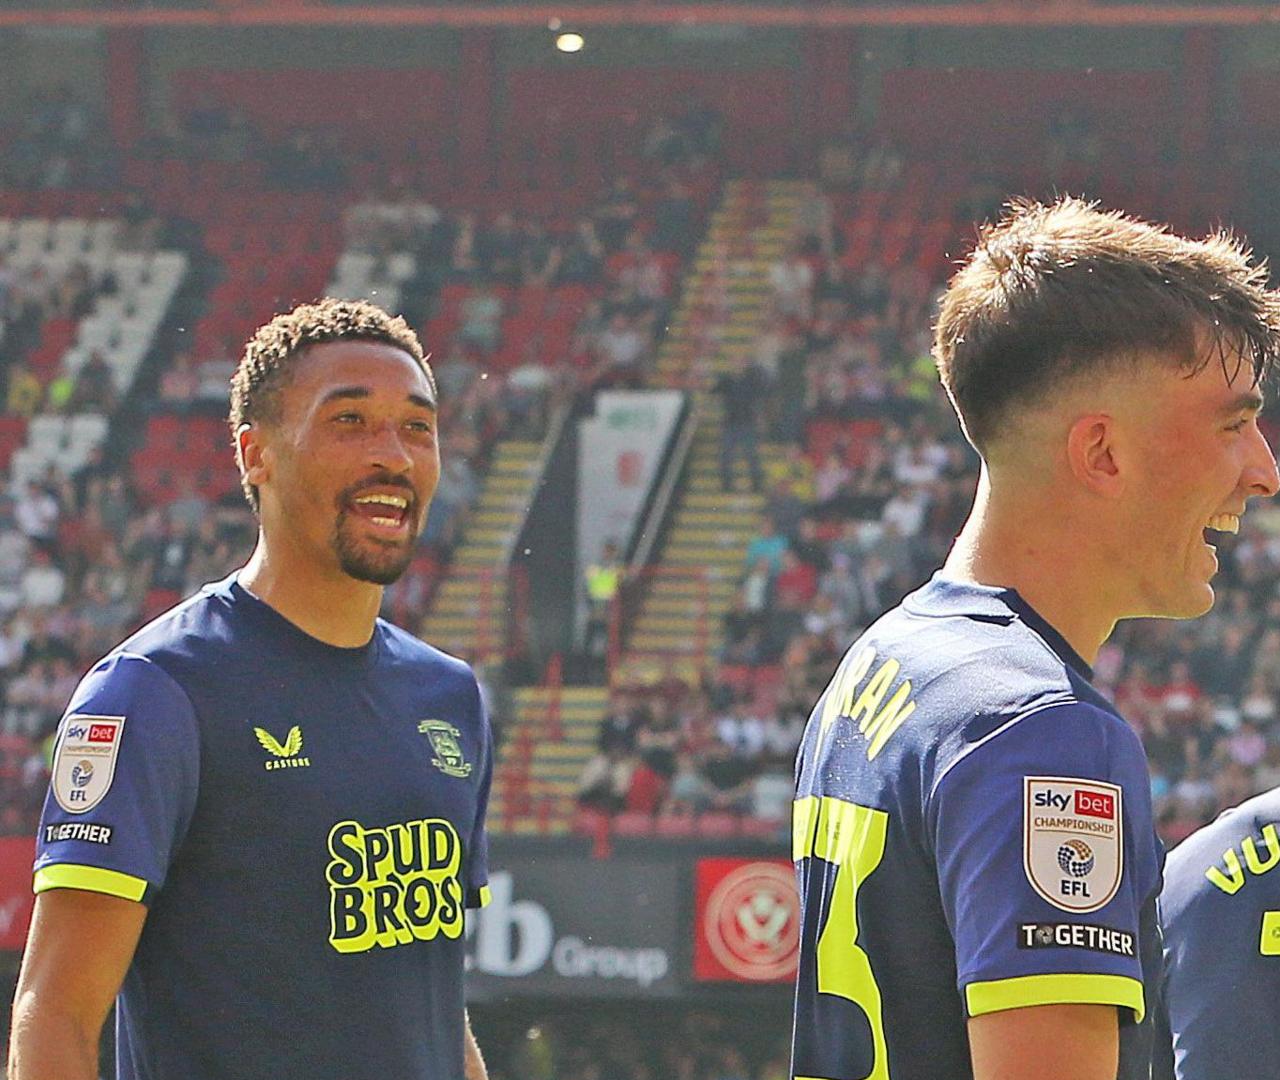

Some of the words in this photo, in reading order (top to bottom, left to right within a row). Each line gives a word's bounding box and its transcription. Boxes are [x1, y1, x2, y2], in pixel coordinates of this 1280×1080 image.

[68, 724, 87, 739] sky
[91, 727, 113, 739] bet
[70, 790, 86, 801] EFL
[1035, 790, 1072, 811] sky
[1079, 794, 1111, 814] bet
[1034, 817, 1114, 833] CHAMPIONSHIP
[326, 818, 461, 886] SPUD
[1061, 880, 1091, 897] EFL
[329, 876, 465, 952] BROS
